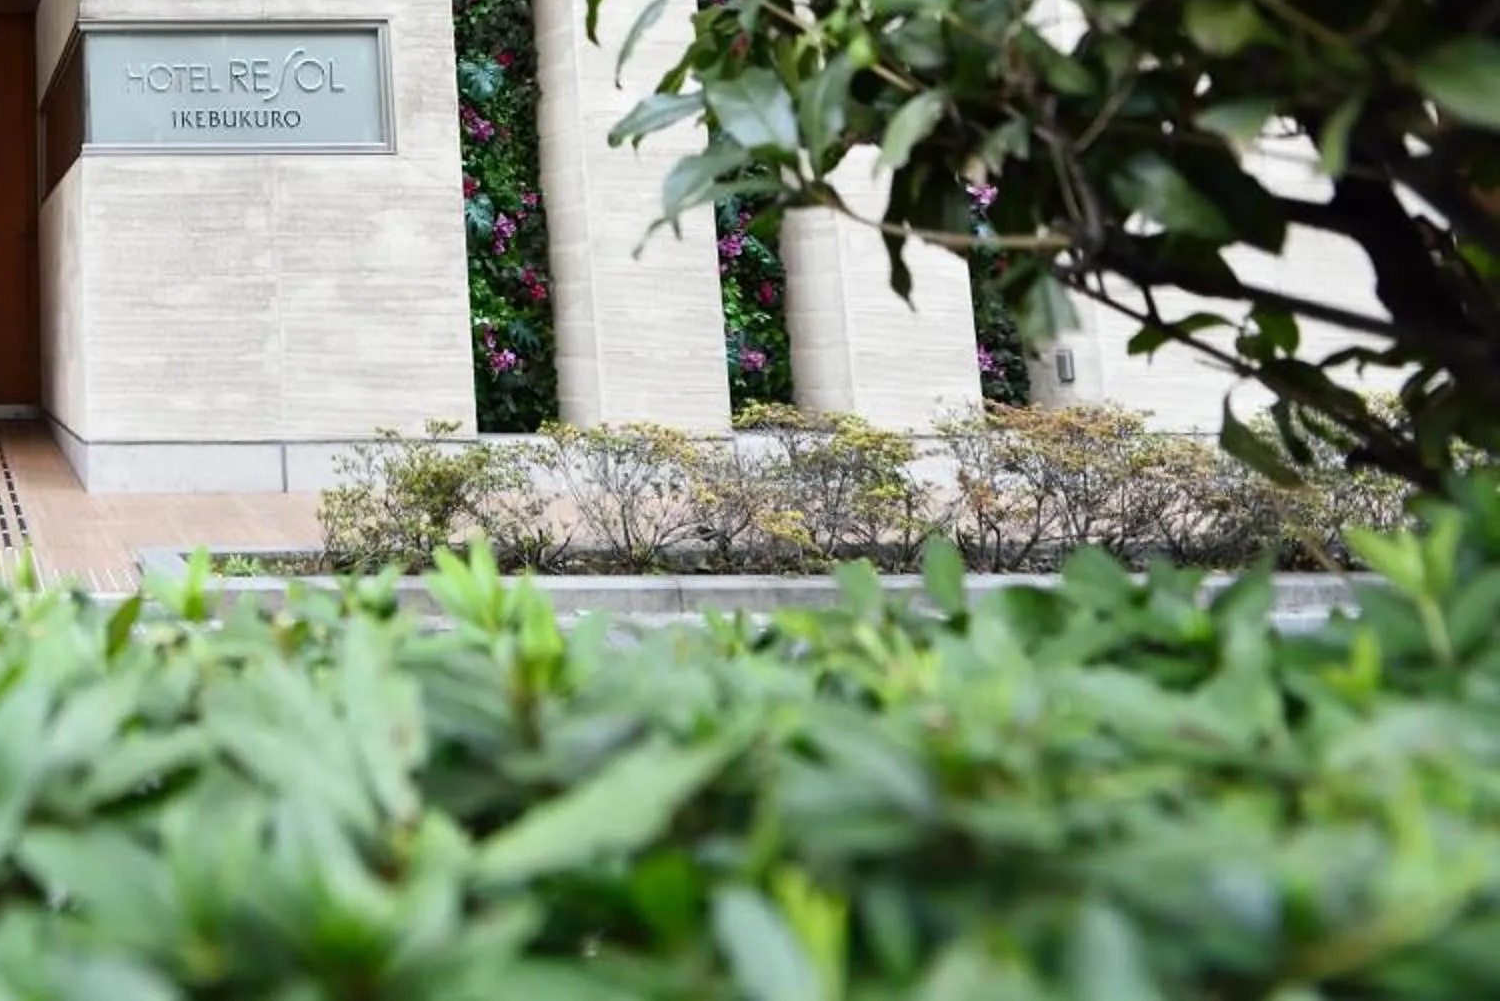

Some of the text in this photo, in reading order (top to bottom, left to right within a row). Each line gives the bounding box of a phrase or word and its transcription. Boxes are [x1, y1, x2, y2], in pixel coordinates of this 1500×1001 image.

[125, 46, 346, 102] HOTEL RESOL
[171, 109, 302, 129] IKEBUKURO
